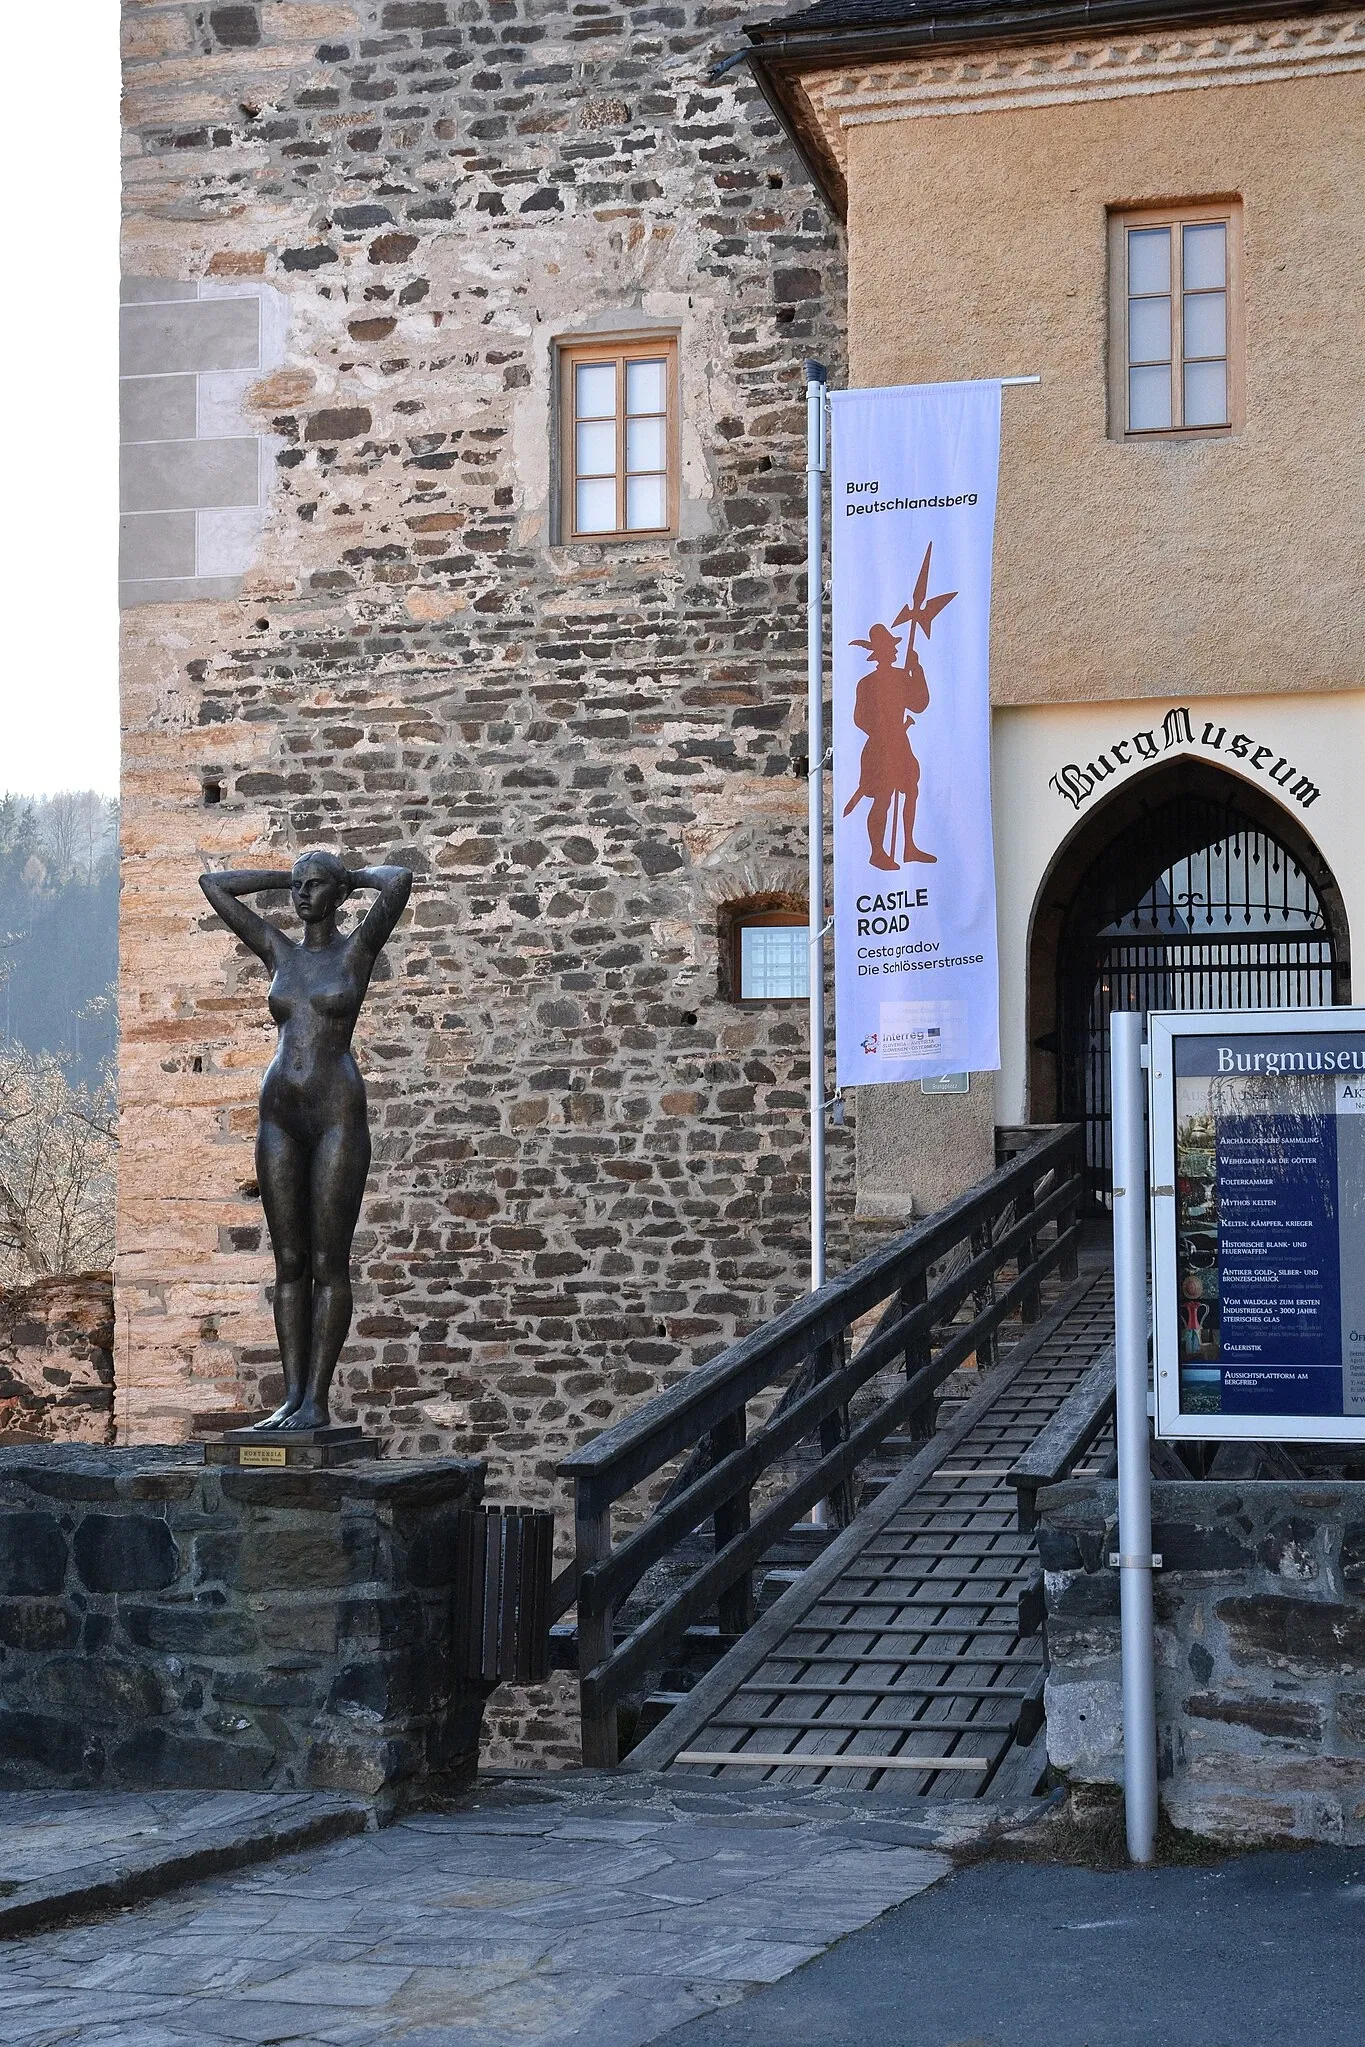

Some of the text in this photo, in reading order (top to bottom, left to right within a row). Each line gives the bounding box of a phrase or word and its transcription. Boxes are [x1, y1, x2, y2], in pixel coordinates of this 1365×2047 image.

[846, 481, 879, 494] Burg
[846, 493, 977, 516] Deutschlandsberg
[1049, 707, 1321, 810] BurgMuseum
[856, 888, 928, 913] CASTLE
[857, 914, 910, 937] ROAD
[857, 941, 940, 959] Cesta gradov
[858, 953, 984, 976] Die Schlösserstrasse
[882, 1031, 924, 1042] Interreg
[1217, 1047, 1365, 1075] Burgmuseu
